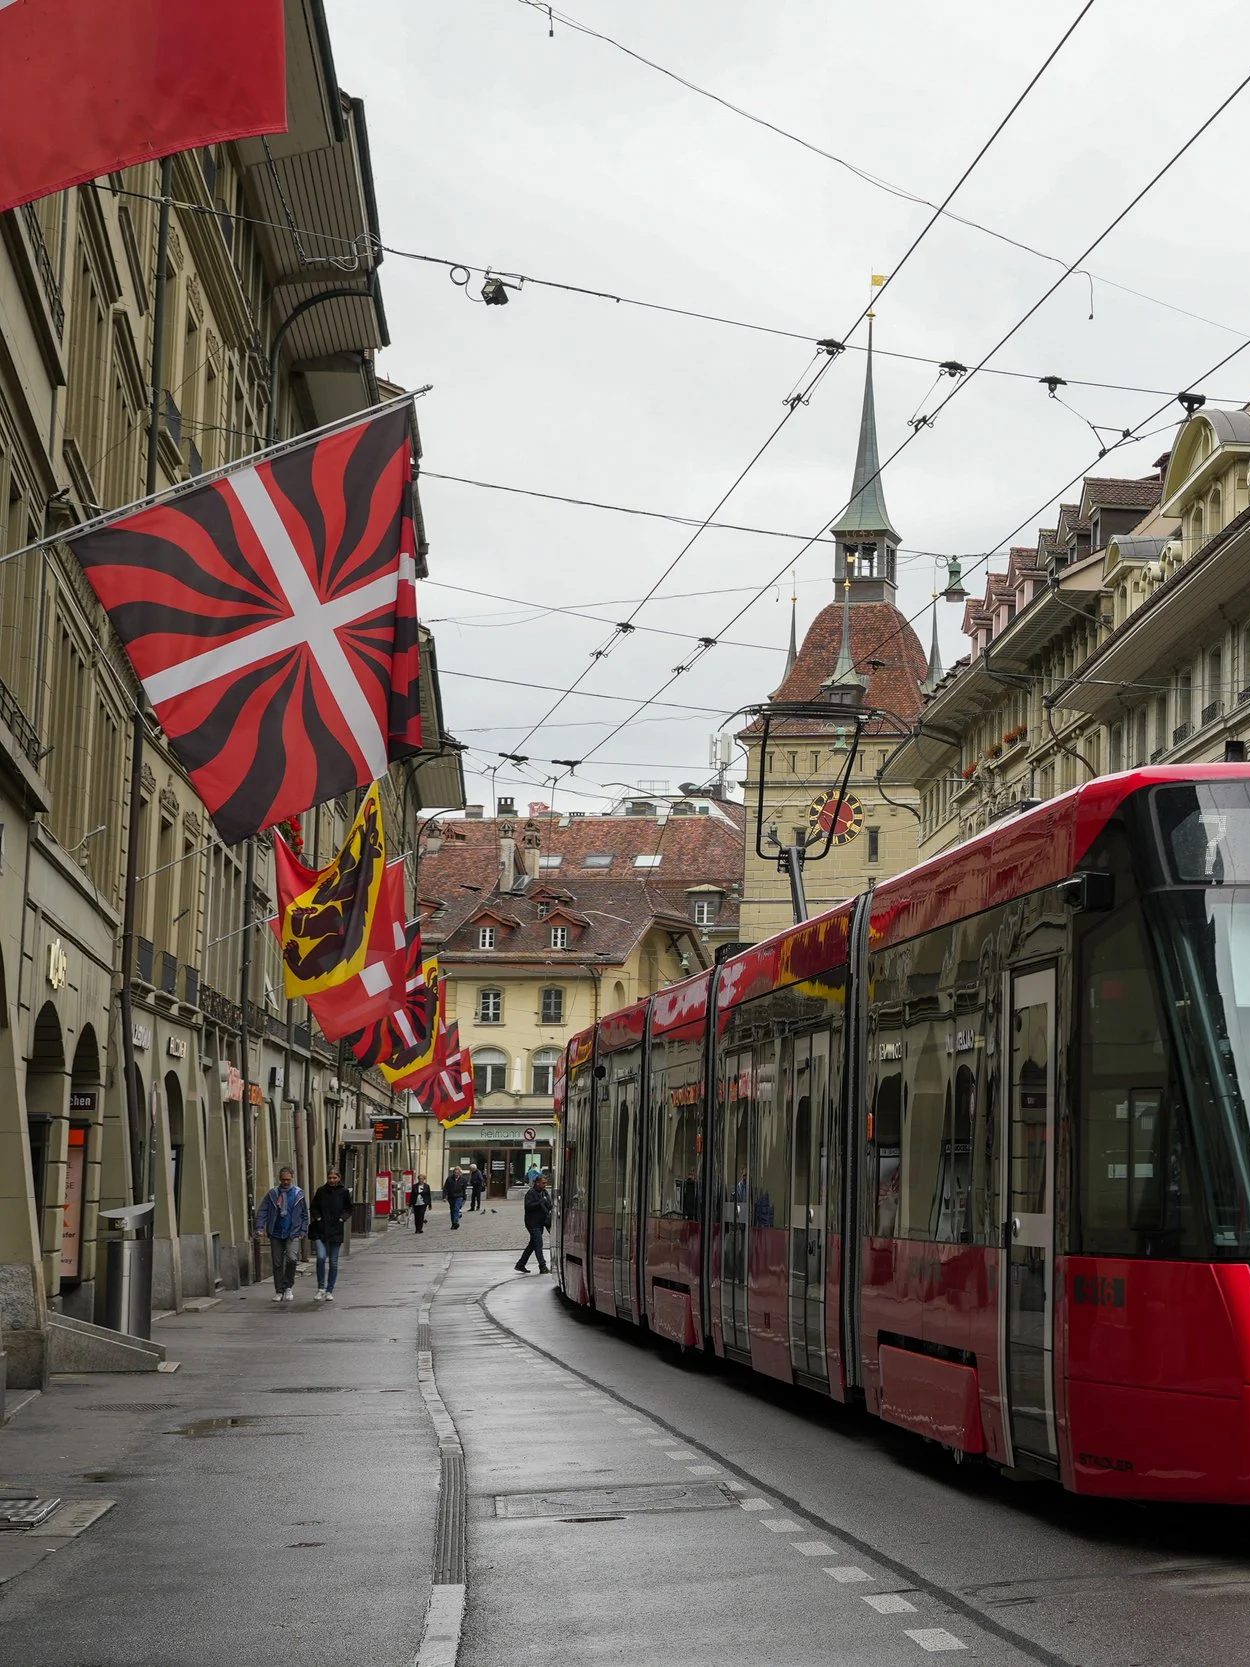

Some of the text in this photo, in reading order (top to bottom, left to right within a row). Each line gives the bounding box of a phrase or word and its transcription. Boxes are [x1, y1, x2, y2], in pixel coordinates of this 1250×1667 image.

[1199, 815, 1227, 874] 7
[480, 1128, 521, 1138] fielmann
[1079, 1452, 1135, 1473] STADLER
